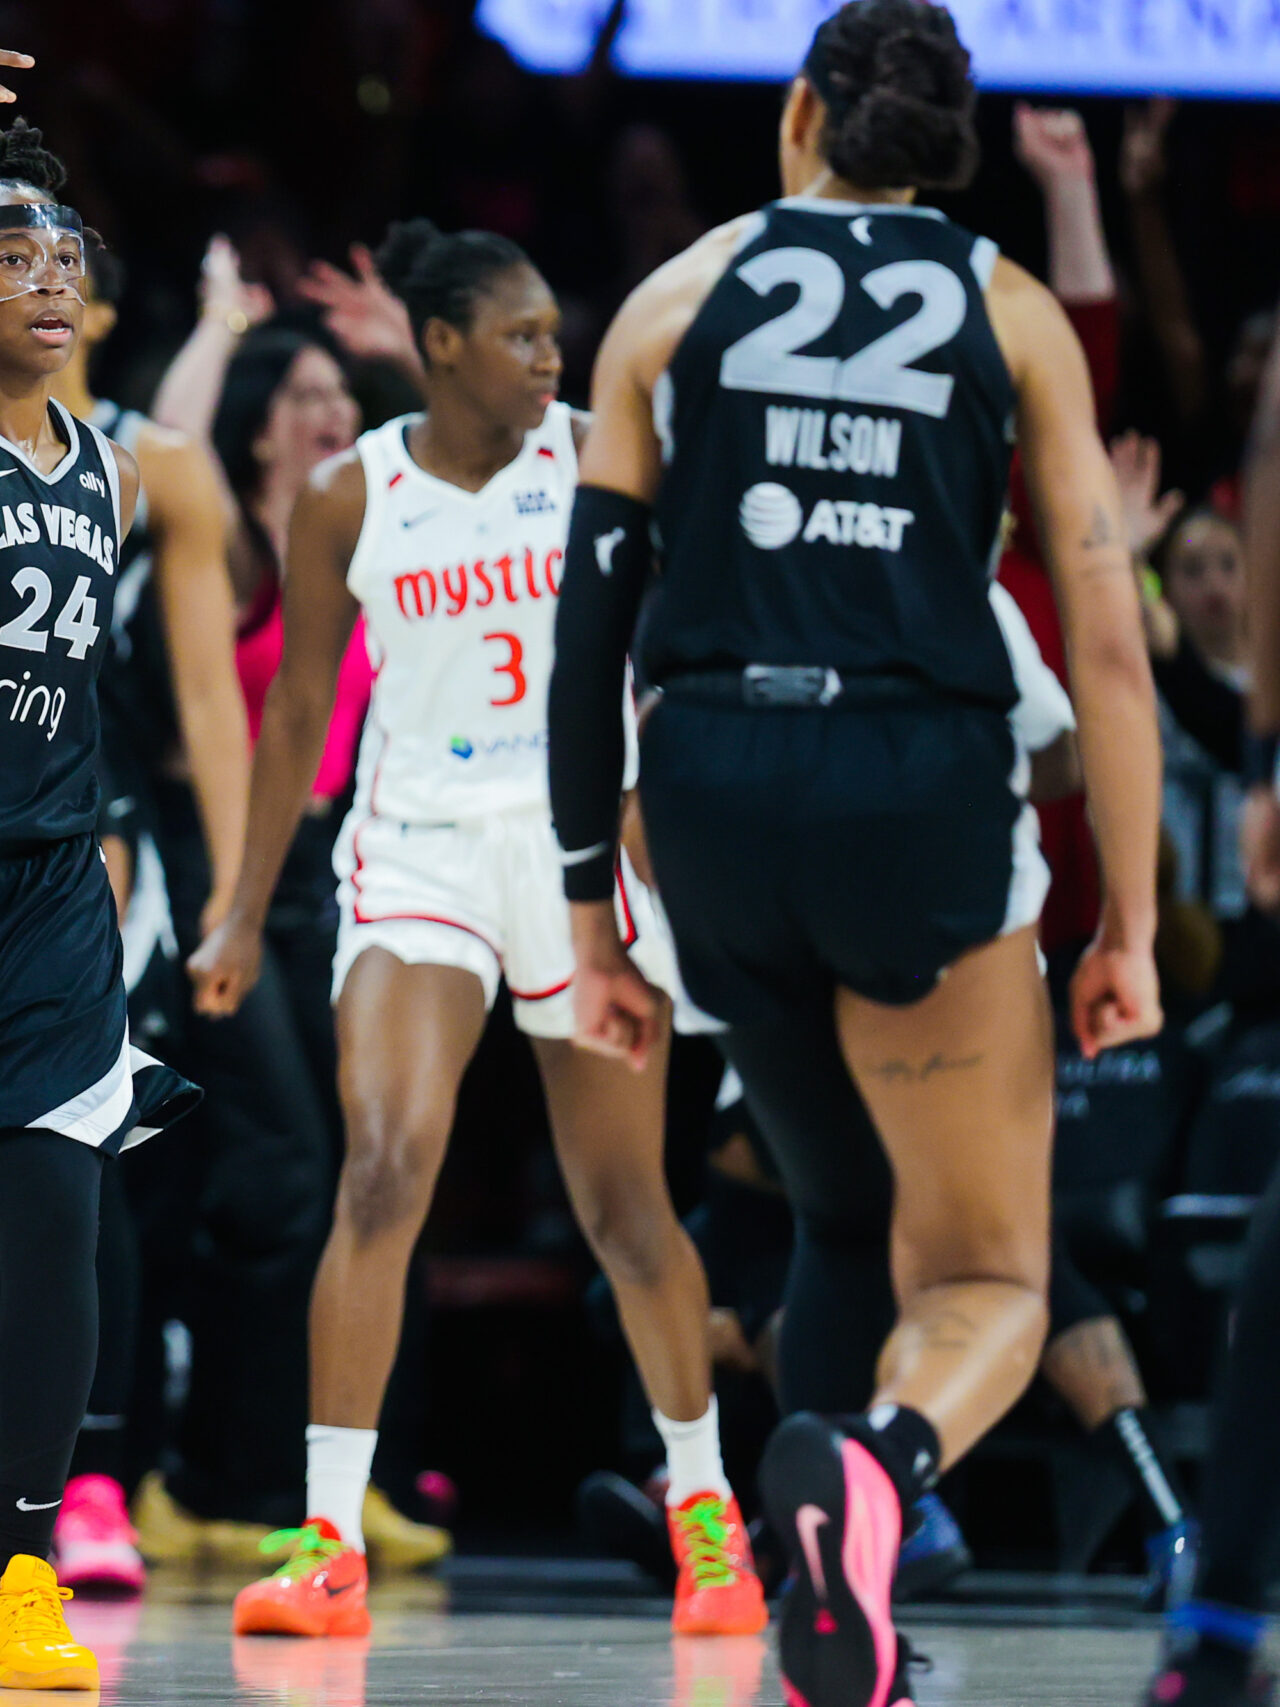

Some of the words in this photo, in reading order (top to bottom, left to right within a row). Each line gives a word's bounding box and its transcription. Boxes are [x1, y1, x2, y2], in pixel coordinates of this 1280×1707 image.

[720, 246, 967, 419] 22
[765, 405, 902, 478] WILSON
[79, 471, 106, 498] ally
[40, 502, 114, 575] VEGAS
[802, 499, 914, 552] AT&T
[394, 547, 562, 619] mystic
[483, 630, 527, 706] 3
